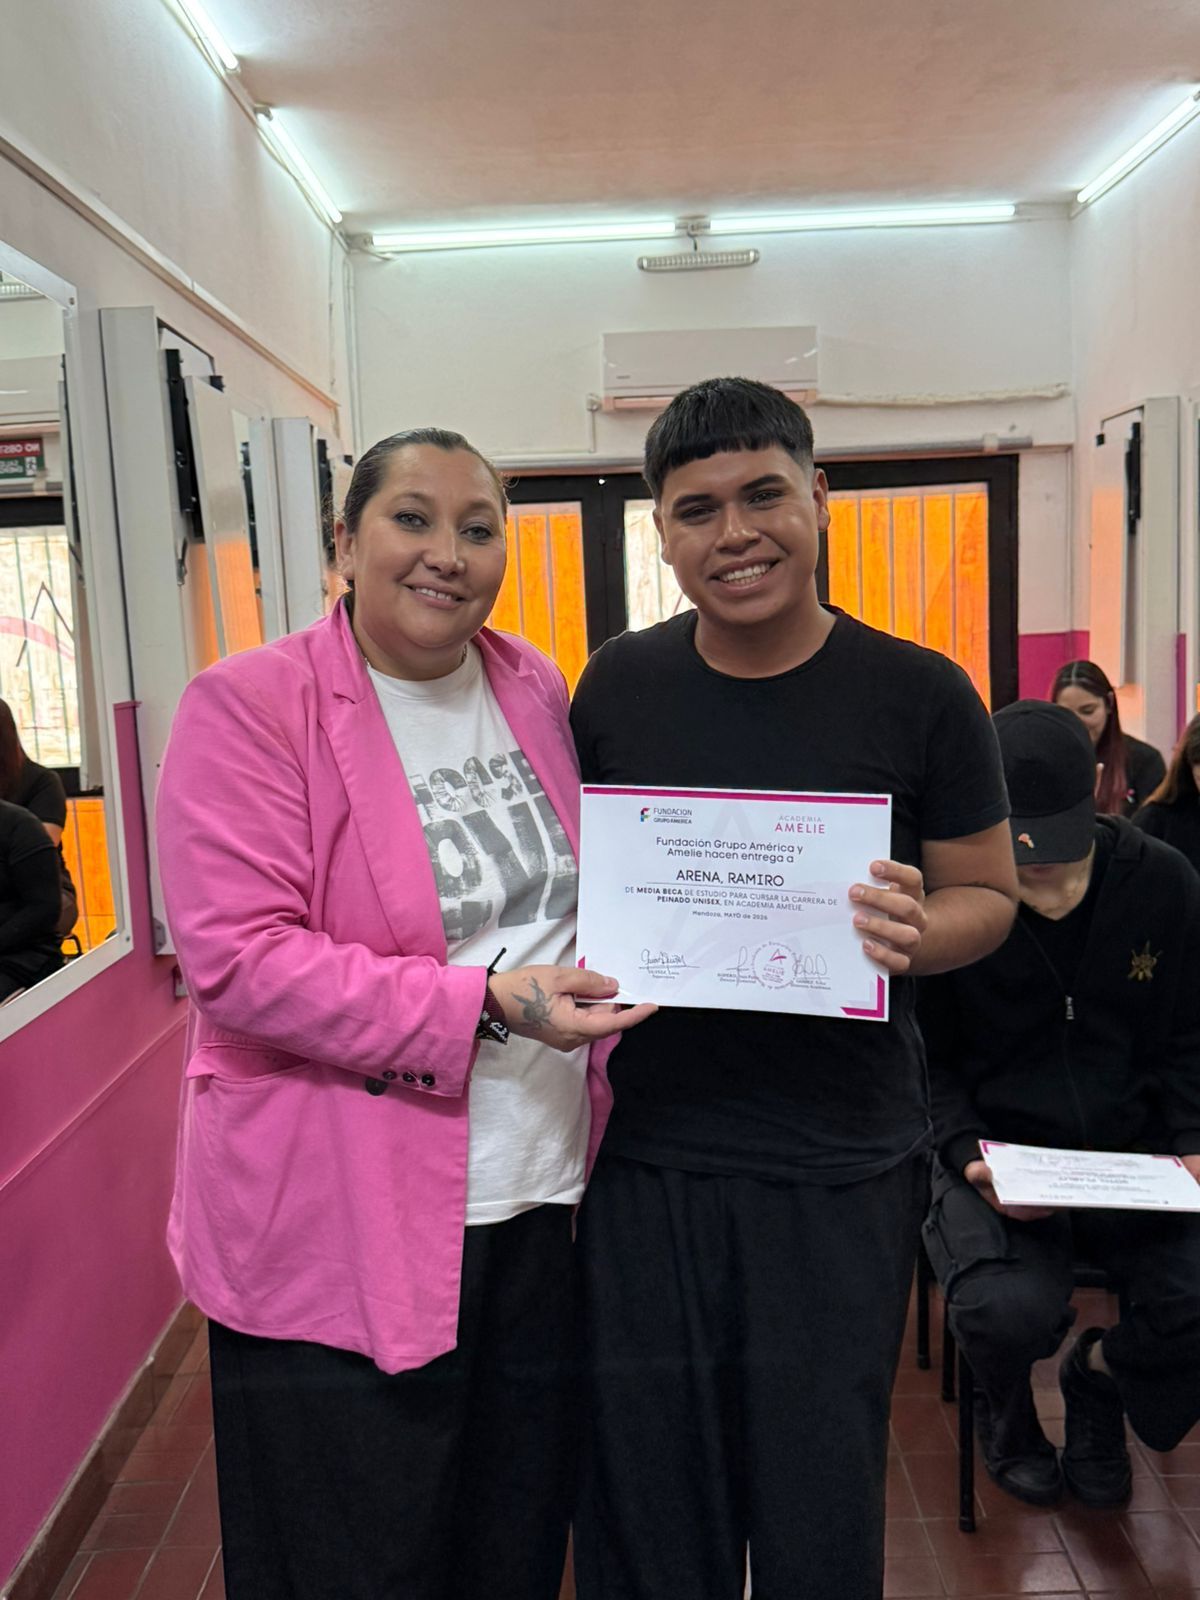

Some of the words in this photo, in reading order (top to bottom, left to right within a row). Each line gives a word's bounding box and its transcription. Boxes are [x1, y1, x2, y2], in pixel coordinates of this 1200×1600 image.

[774, 822, 825, 834] AMELIE
[656, 836, 712, 848] Fundación
[713, 839, 747, 851] Grupo
[749, 842, 795, 853] América
[796, 846, 804, 855] y
[667, 848, 702, 857] Amelie
[704, 849, 739, 859] hacen
[741, 852, 784, 864] entrega
[786, 855, 794, 863] a
[676, 869, 724, 884] ARENA,
[727, 872, 785, 887] RAMIRO
[696, 890, 727, 898] ESTUDIO
[729, 891, 748, 899] PARA
[750, 893, 779, 901] CURSAR
[791, 896, 826, 904] CARRERA
[828, 898, 838, 906] DE
[736, 900, 775, 908] ACADEMIA
